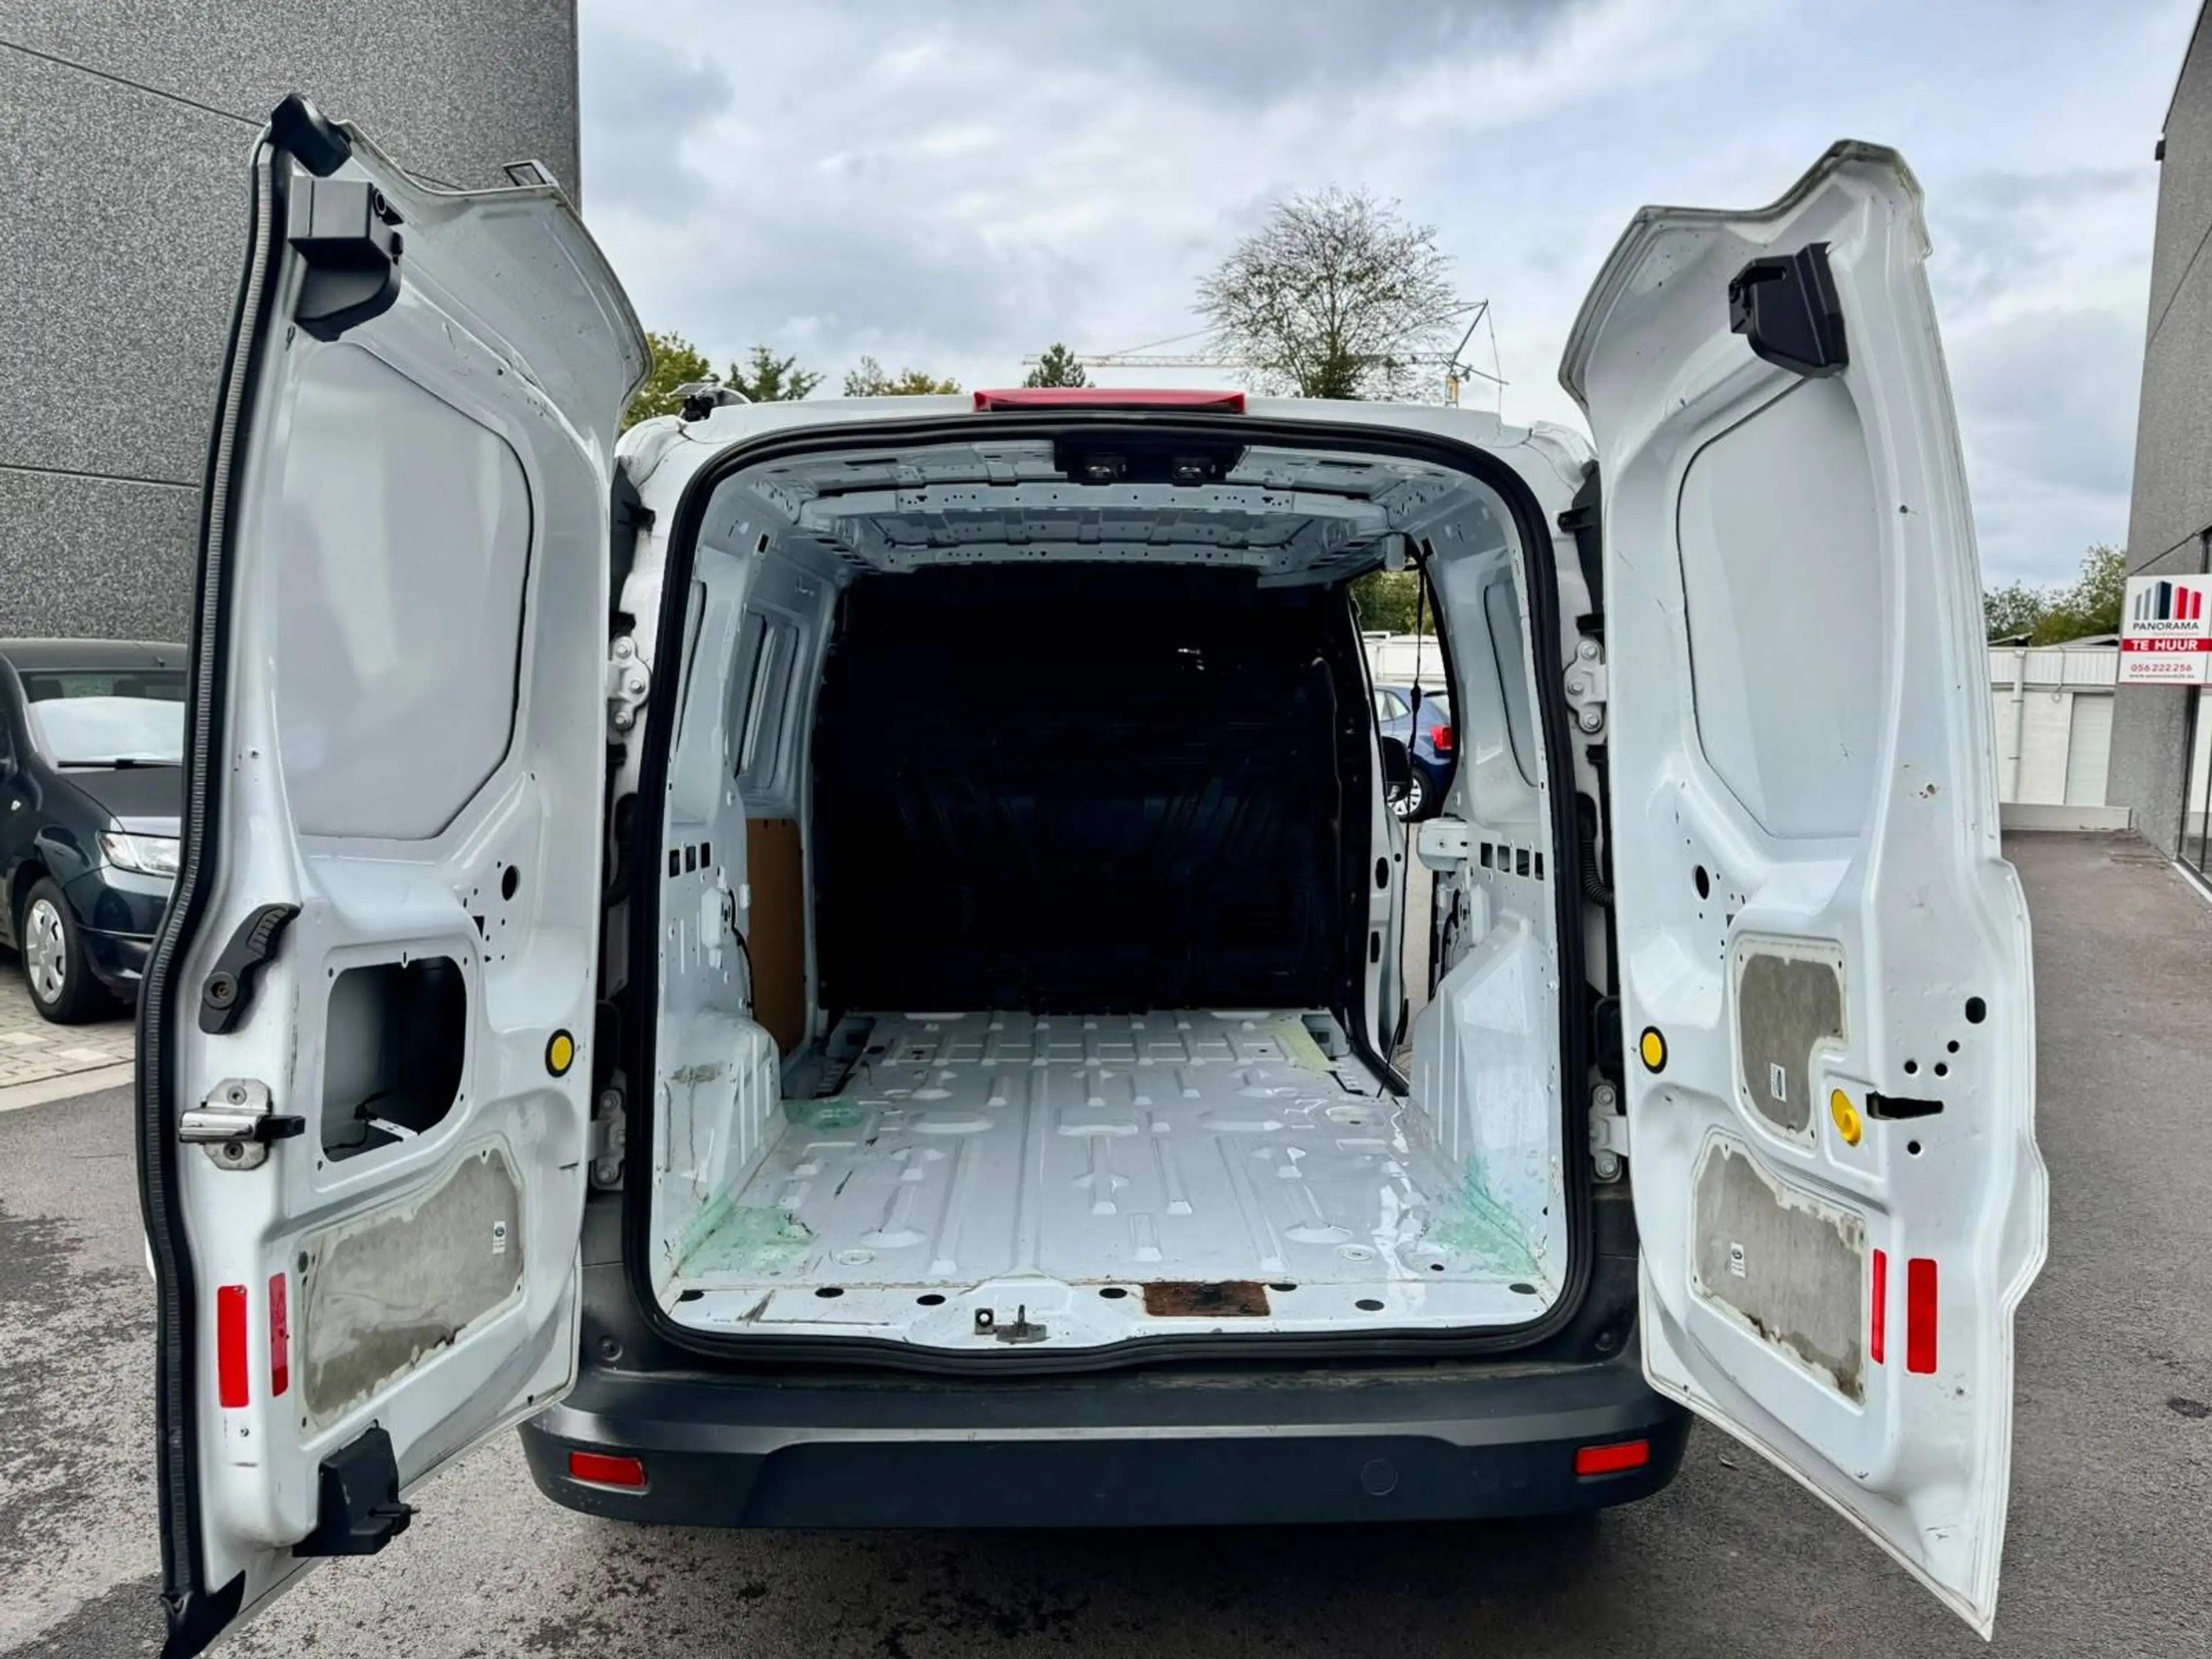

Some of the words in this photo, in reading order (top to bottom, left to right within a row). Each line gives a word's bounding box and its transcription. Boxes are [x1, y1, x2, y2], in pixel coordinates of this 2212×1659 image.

[2133, 622, 2199, 631] PANORAMA
[2132, 639, 2150, 650] TE
[2154, 639, 2198, 650] HUUR
